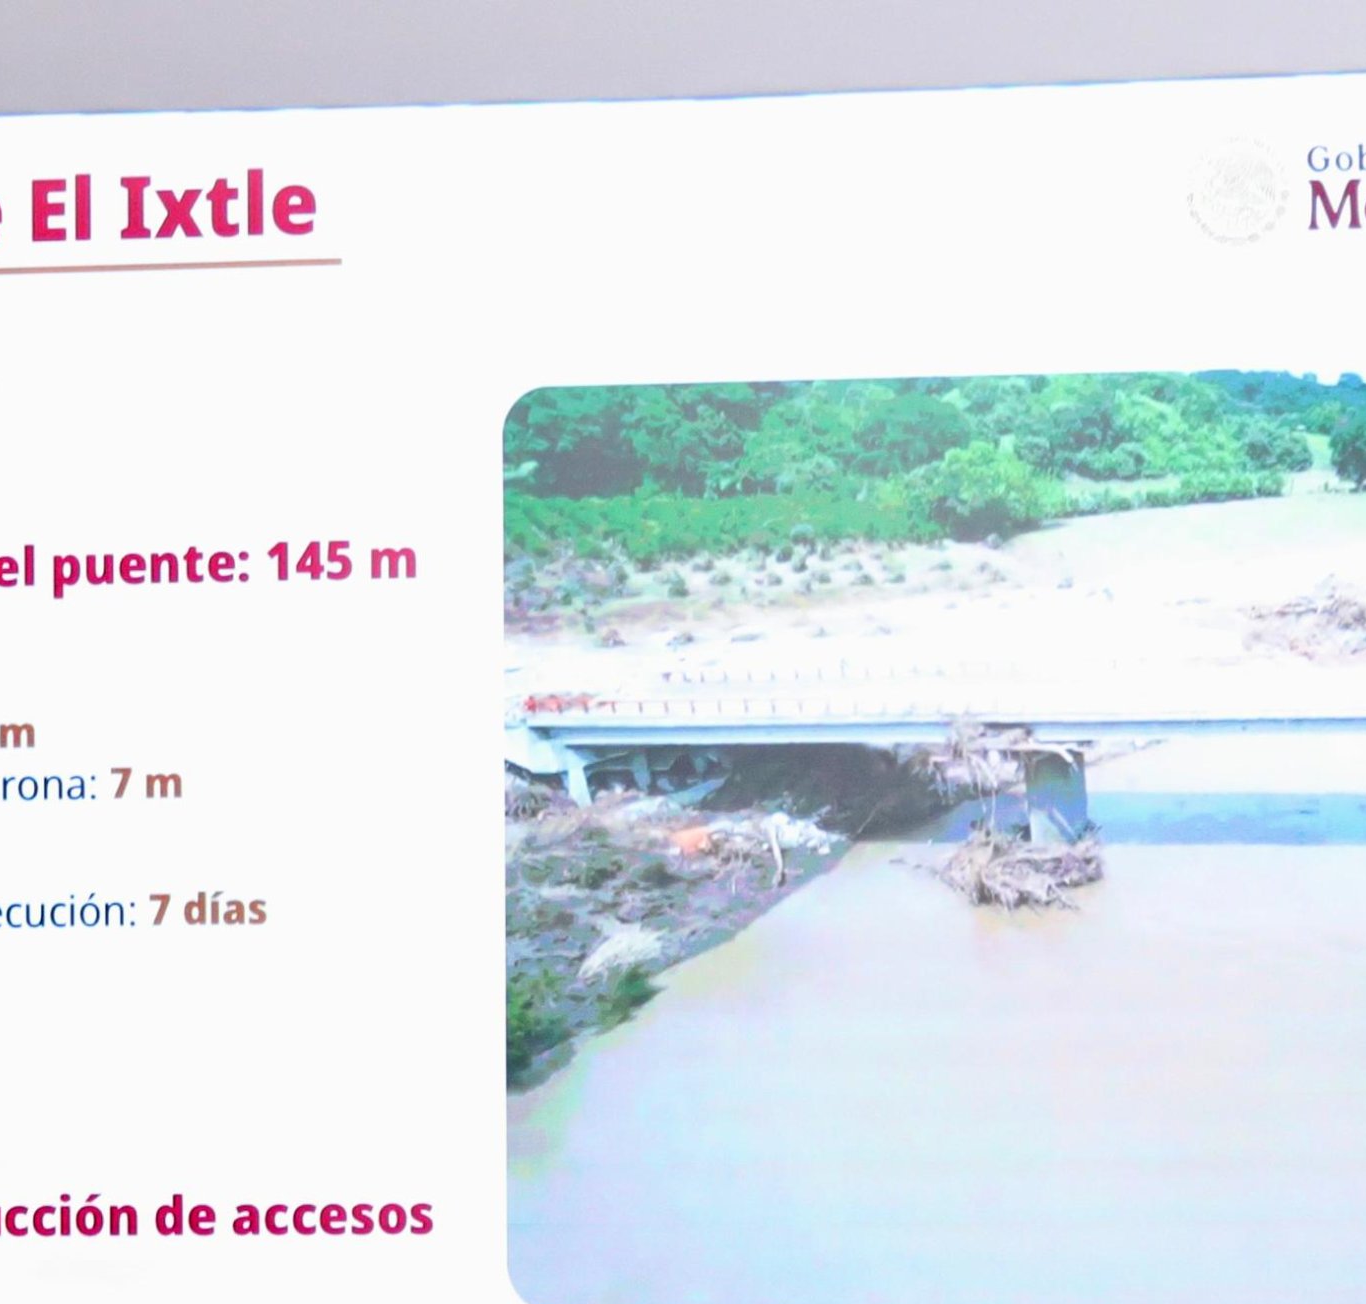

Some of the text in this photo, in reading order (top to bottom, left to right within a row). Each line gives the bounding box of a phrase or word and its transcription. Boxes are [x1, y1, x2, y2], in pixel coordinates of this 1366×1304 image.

[30, 172, 92, 243] El
[119, 167, 317, 240] Ixtle
[52, 545, 250, 600] puente:
[266, 539, 353, 582] 145
[370, 546, 417, 580] m
[110, 767, 133, 799] 7
[145, 772, 183, 799] m
[148, 893, 172, 926] 7
[183, 890, 268, 926] días
[154, 1192, 217, 1237] de
[231, 1202, 434, 1237] accesos
